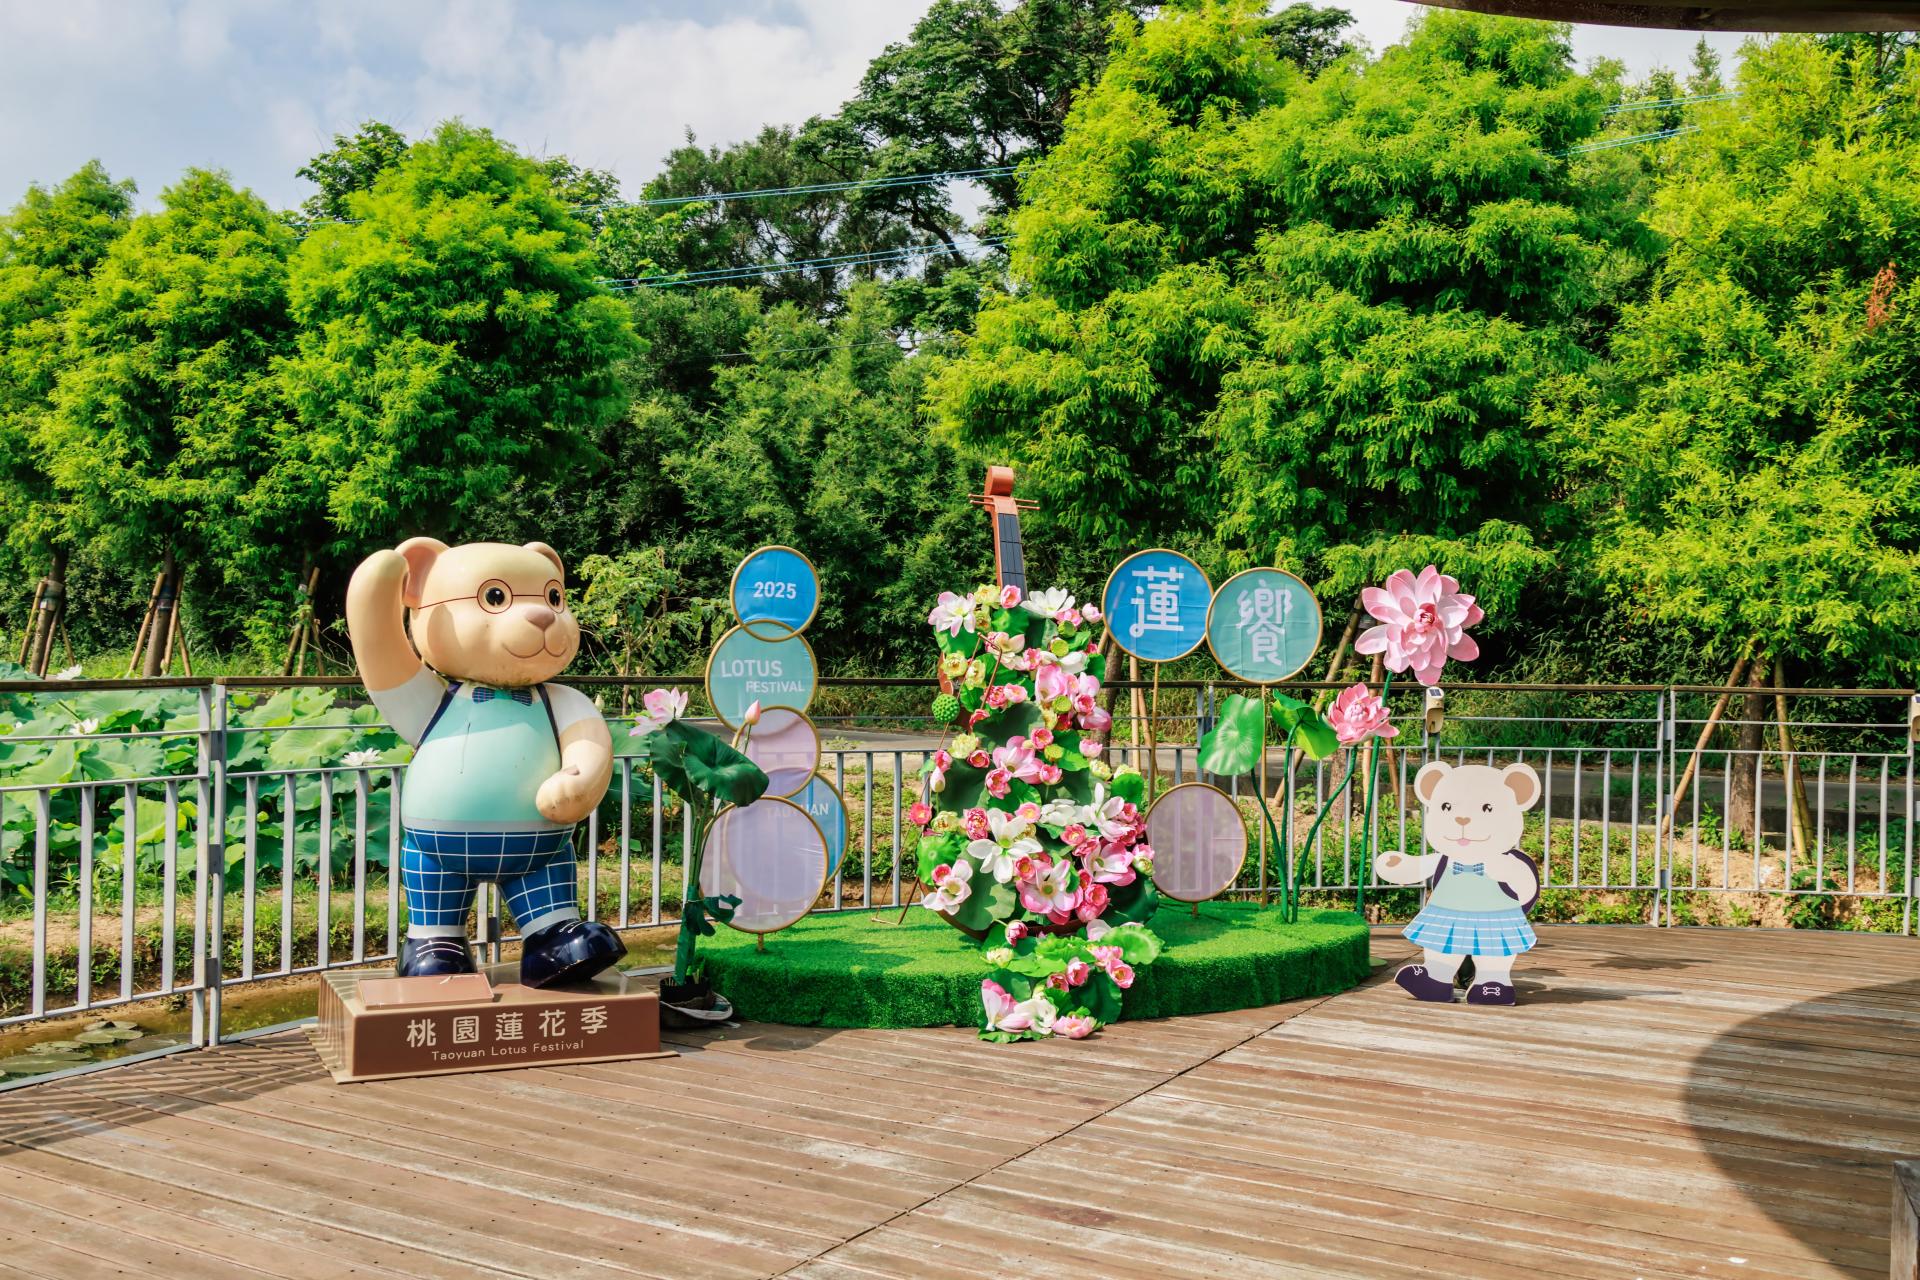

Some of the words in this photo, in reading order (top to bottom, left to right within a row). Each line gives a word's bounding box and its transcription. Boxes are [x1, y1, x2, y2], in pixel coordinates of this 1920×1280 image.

[753, 581, 797, 600] 2025
[1129, 565, 1185, 638] 蓮
[1236, 578, 1293, 666] 饗
[720, 659, 783, 678] LOTUS
[745, 680, 805, 694] FESTIVAL
[406, 1005, 609, 1048] 桃園蓮花季
[432, 1049, 486, 1062] Taoyuan
[491, 1046, 527, 1057] Lotus
[533, 1040, 584, 1053] Festival
